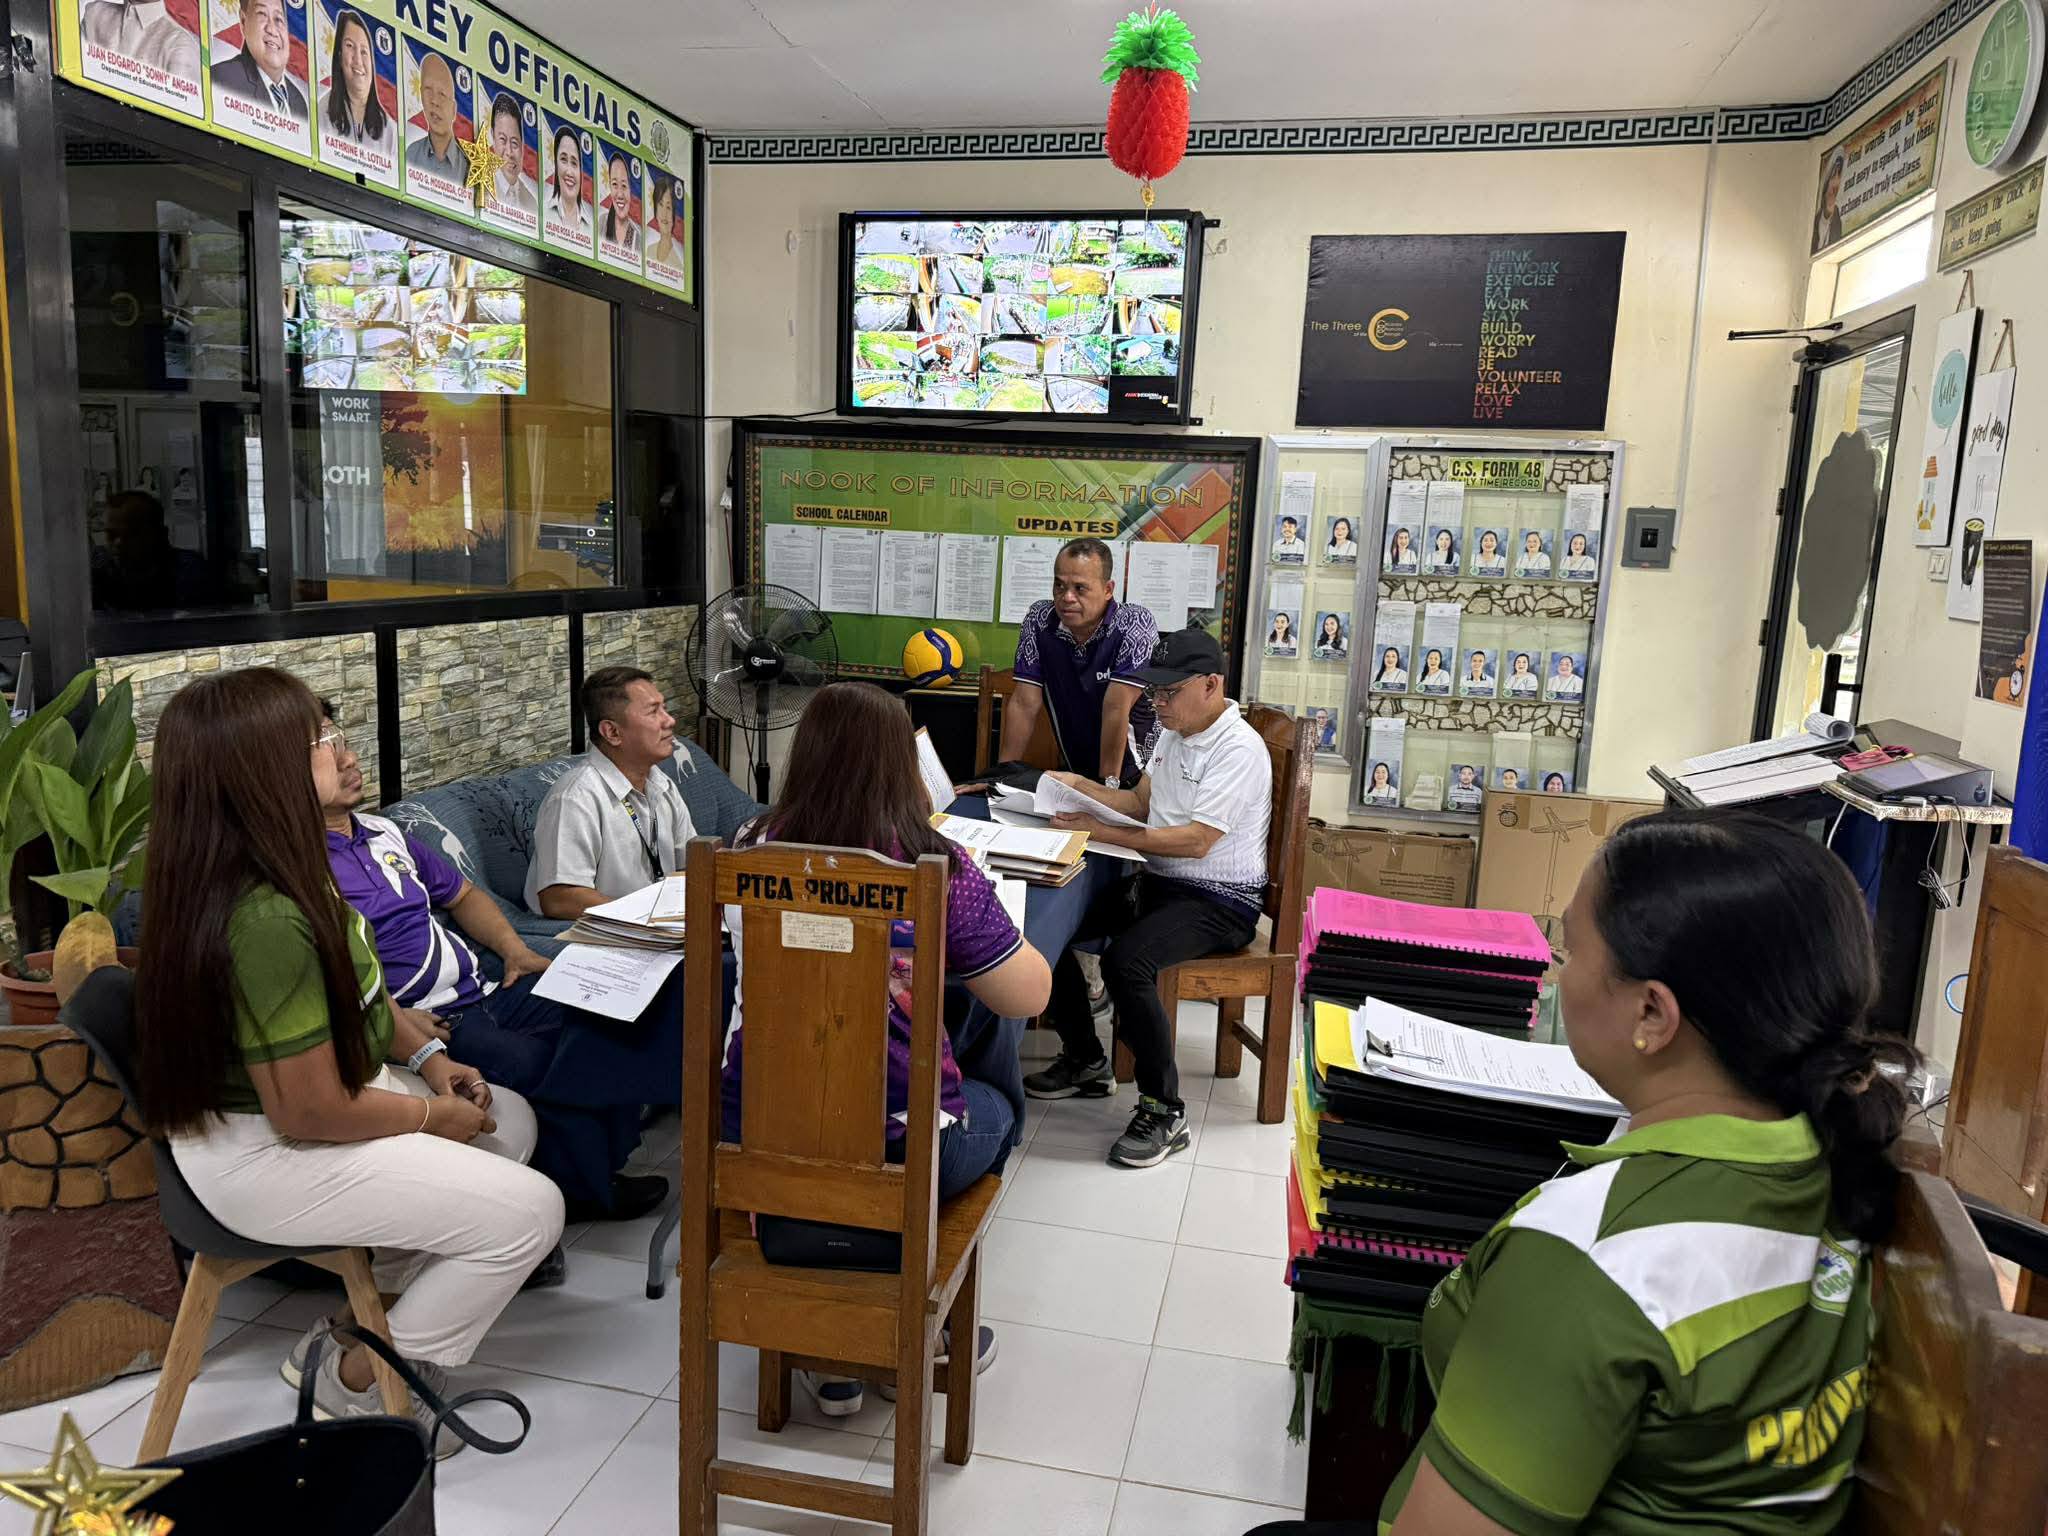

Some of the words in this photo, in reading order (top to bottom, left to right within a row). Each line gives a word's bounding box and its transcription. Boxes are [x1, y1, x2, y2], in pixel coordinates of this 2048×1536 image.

[87, 44, 106, 62] JUAN
[107, 50, 141, 74] EDGARDO
[172, 77, 199, 96] ANGARA
[488, 29, 642, 147] OFFICIALS
[223, 96, 255, 118] CARLITO
[255, 108, 263, 121] D.
[264, 111, 300, 135] ROCAFORT
[367, 152, 392, 170] LOTILLA
[1489, 249, 1534, 262] THINK
[1487, 261, 1560, 274] NETWORK
[1485, 274, 1556, 286] EXERCISE
[1484, 287, 1512, 298] EAT
[1485, 298, 1529, 310] WORK
[1482, 310, 1520, 322] STAY
[1311, 321, 1329, 331] The
[1332, 321, 1362, 331] Three
[1481, 322, 1522, 334] BUILD
[1481, 334, 1536, 346] WORRY
[1479, 346, 1518, 358] READ
[1478, 358, 1495, 370] BE
[1478, 370, 1562, 383] VOLUNTEER
[1475, 382, 1521, 394] RELAX
[332, 397, 370, 409] WORK
[1474, 395, 1513, 406] LOVE
[332, 411, 370, 423] SMART
[1473, 407, 1504, 418] LIVE
[1968, 412, 1992, 456] good
[1990, 415, 2006, 453] day
[1452, 460, 1477, 477] C.S.
[1482, 461, 1519, 478] FORM
[1524, 462, 1541, 478] 48
[1479, 477, 1500, 487] TIME
[1502, 479, 1540, 488] RECORD
[780, 469, 878, 495] NOOK
[891, 475, 935, 497] OF
[951, 477, 1203, 509] INFORMATION
[796, 506, 834, 520] SCHOOL
[836, 508, 888, 523] CALENDAR
[1017, 517, 1114, 534] UPDATES
[736, 872, 794, 901] PTCA
[804, 878, 908, 912] PROJECT
